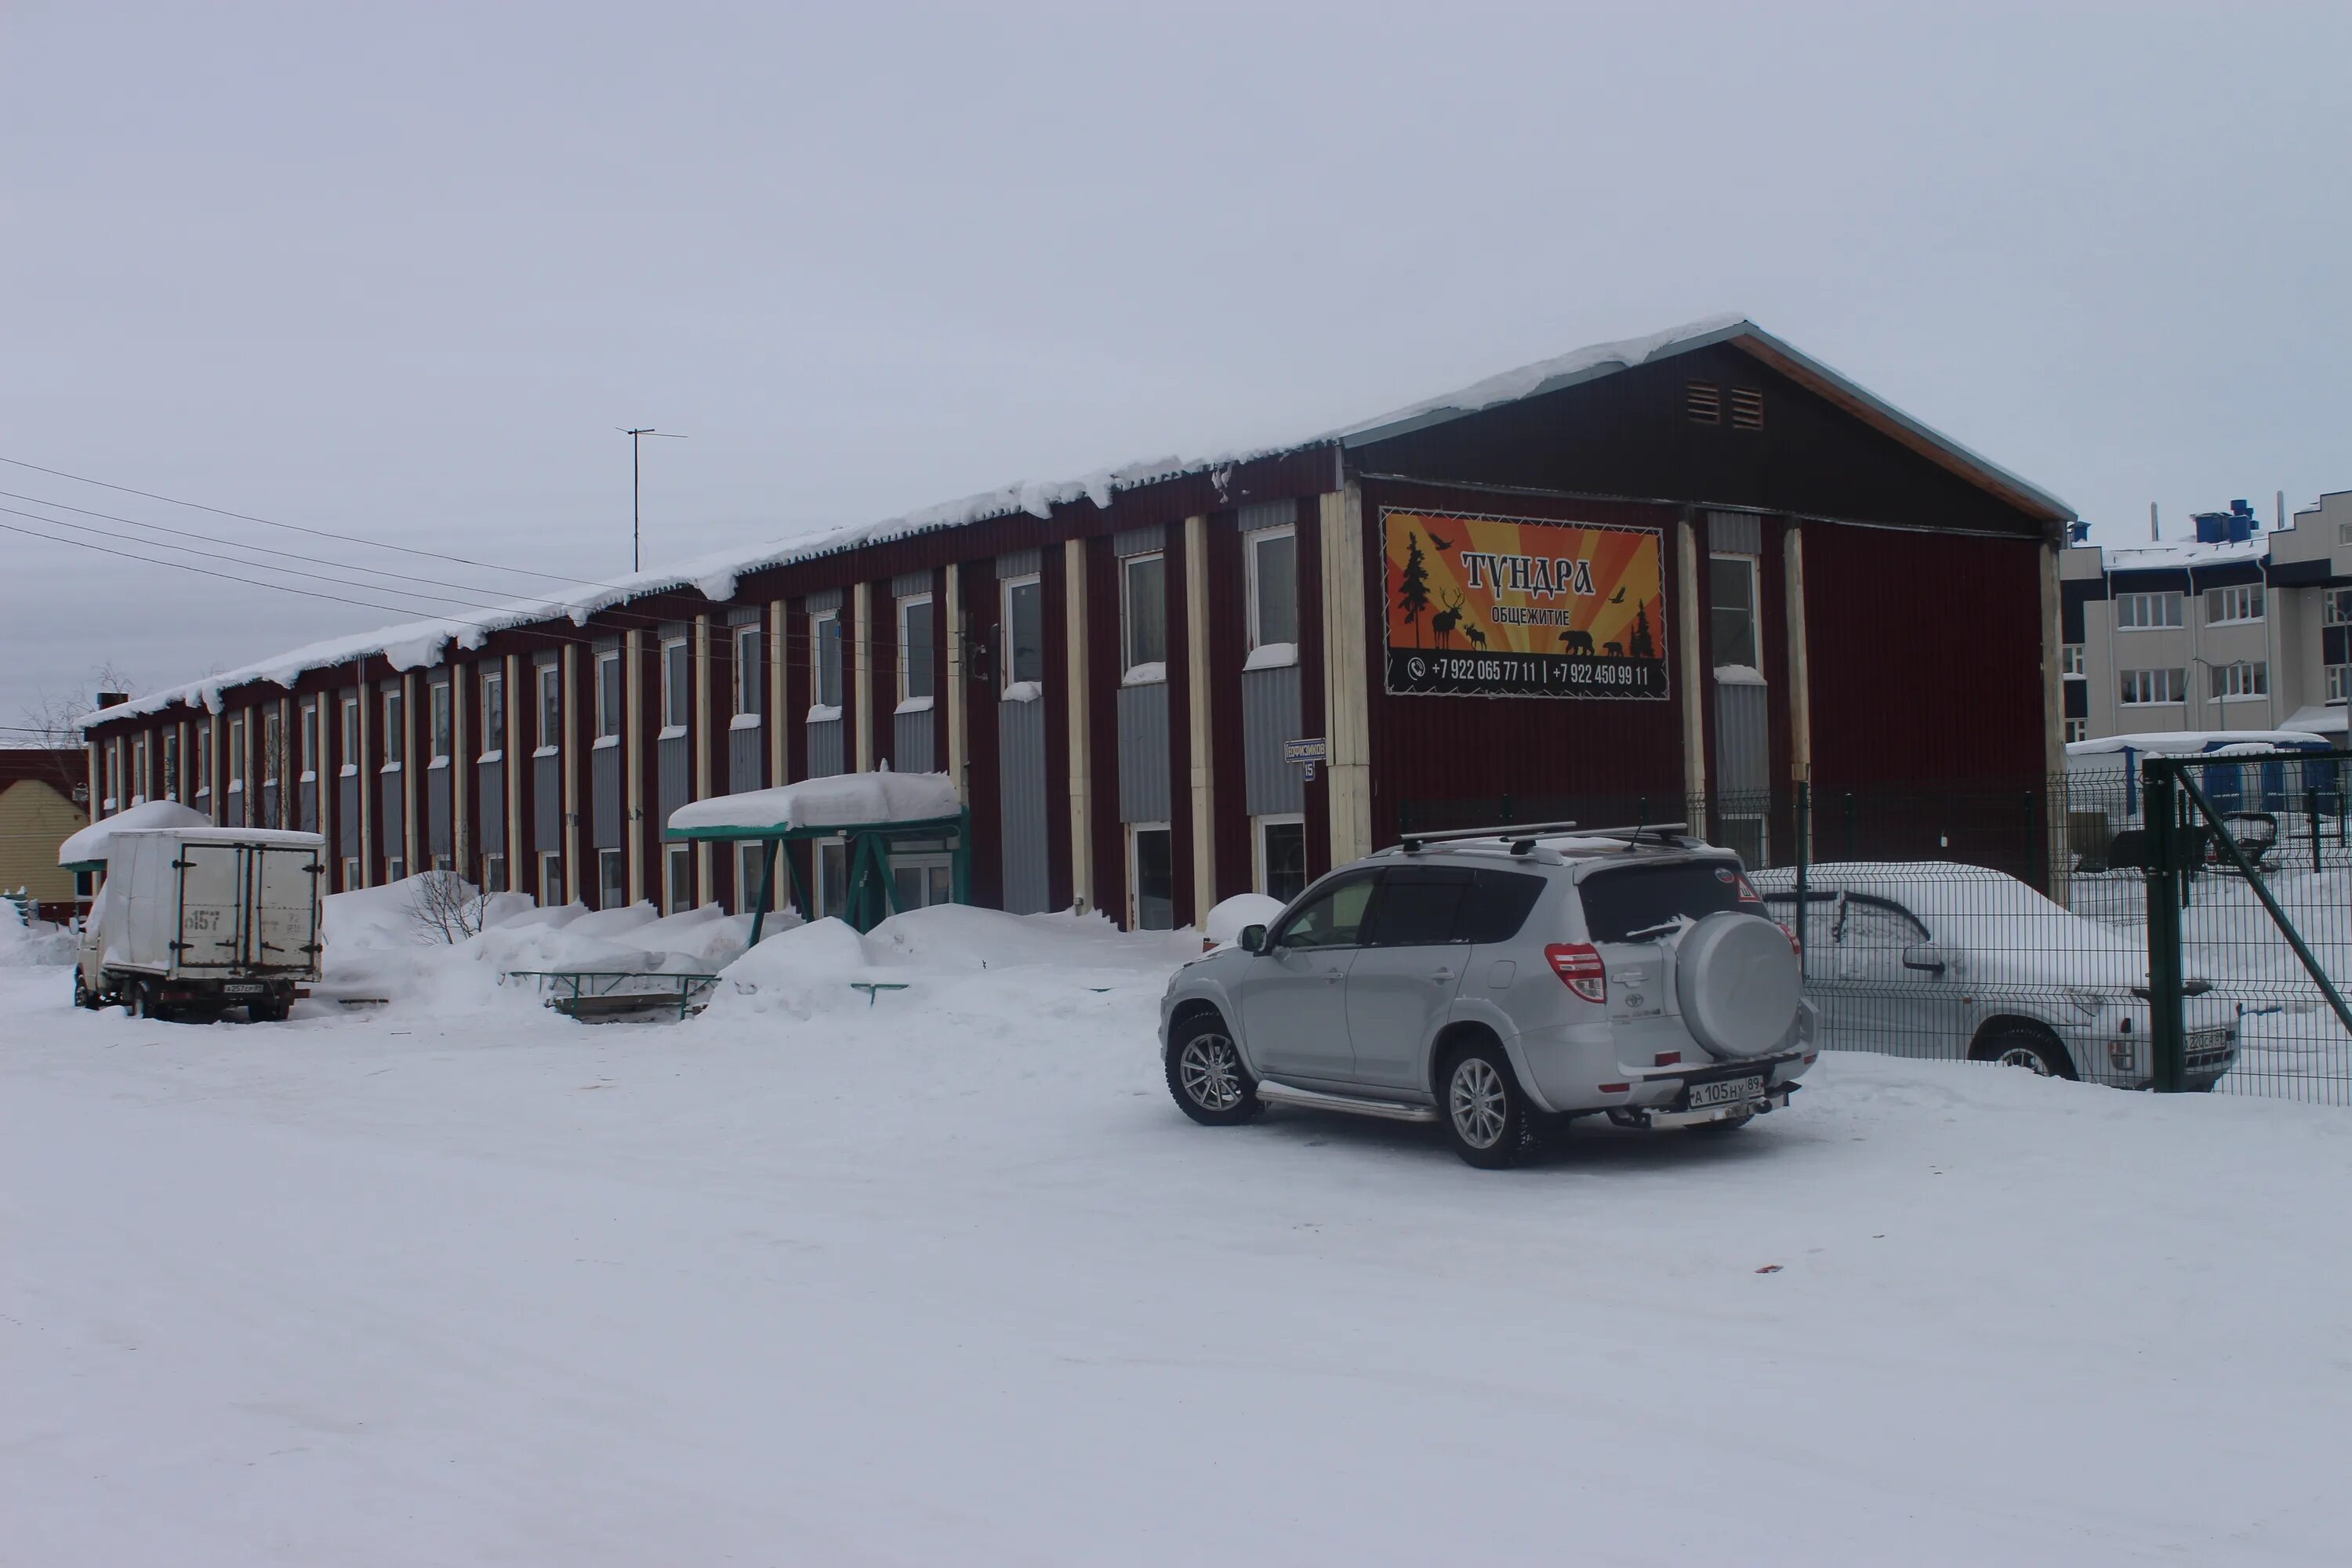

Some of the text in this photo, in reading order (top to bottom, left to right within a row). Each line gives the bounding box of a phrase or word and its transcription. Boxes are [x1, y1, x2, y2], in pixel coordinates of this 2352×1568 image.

[1461, 551, 1595, 600] ТУНДРА
[1492, 606, 1570, 626] ОБЩЕЖИТИЕ
[1432, 659, 1535, 681] +7 922 065 77 11
[1553, 663, 1648, 685] +7 922 450 99 11
[1286, 743, 1325, 758] ГЕОФИЗИКОВ
[1305, 764, 1313, 776] 15
[1748, 1077, 1759, 1091] 89
